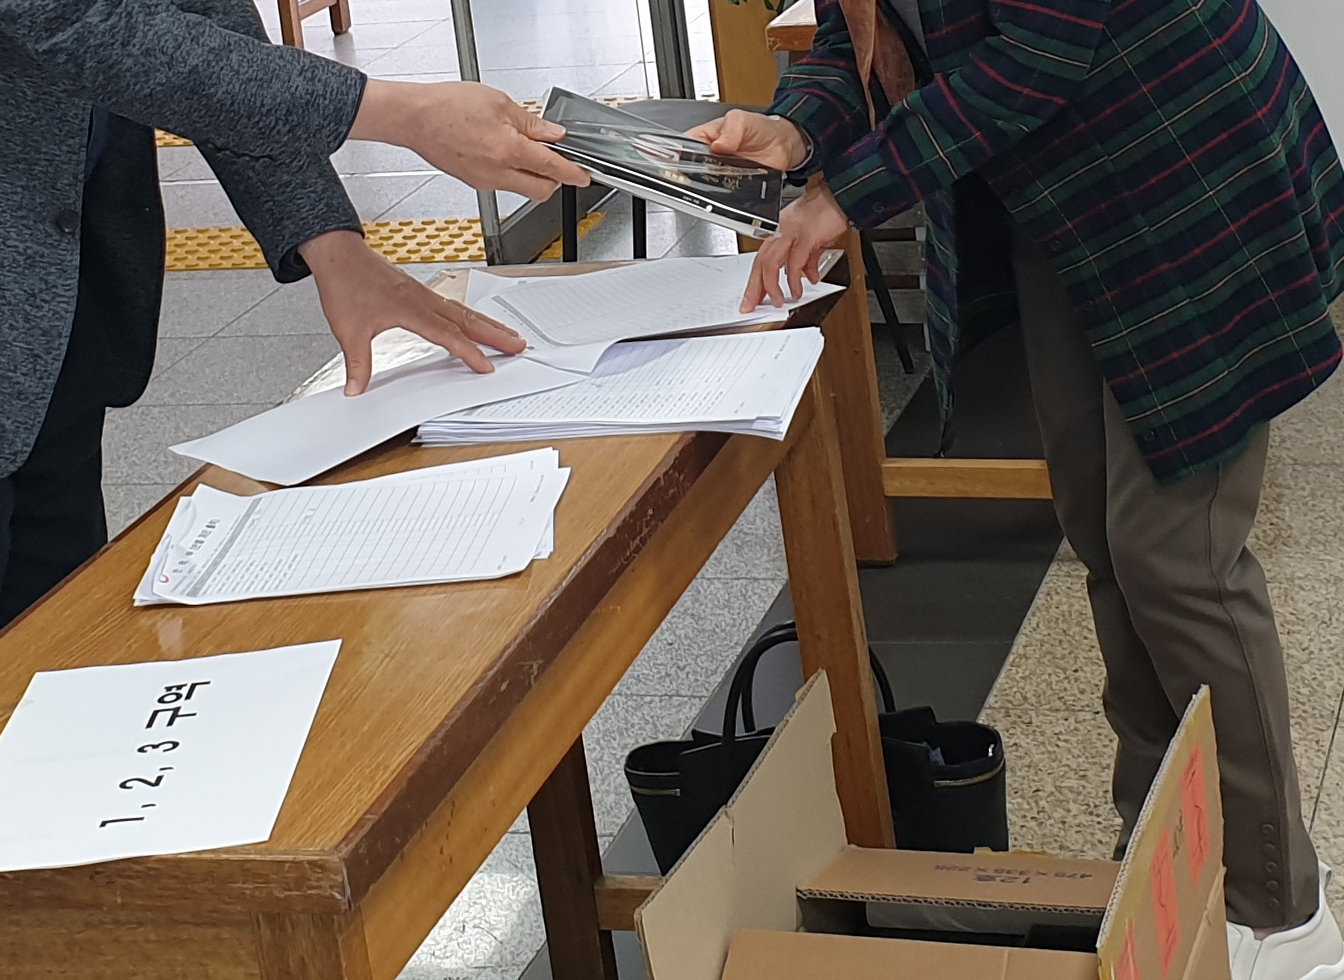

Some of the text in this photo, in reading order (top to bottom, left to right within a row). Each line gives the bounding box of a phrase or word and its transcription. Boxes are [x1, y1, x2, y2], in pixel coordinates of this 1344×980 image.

[99, 681, 211, 828] 1, 2, 3 구역
